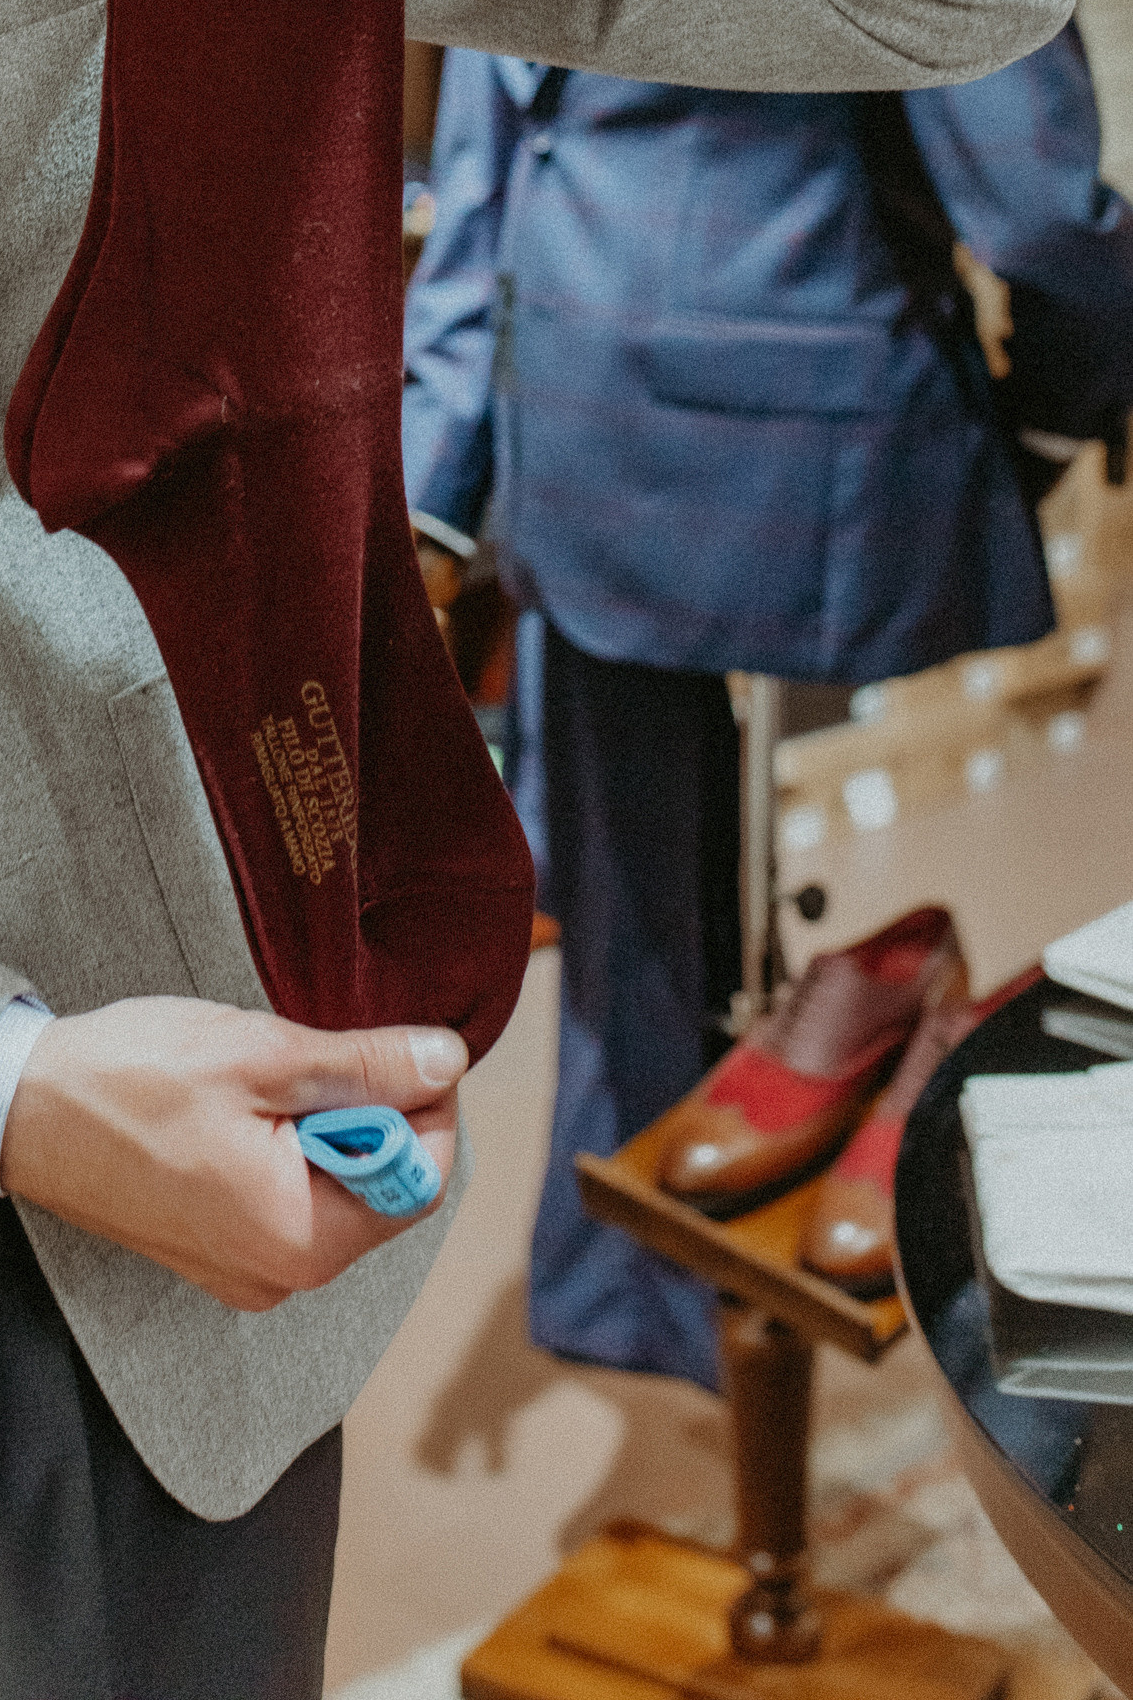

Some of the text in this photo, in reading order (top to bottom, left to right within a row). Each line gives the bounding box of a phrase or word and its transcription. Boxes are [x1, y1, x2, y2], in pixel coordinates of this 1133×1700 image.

[261, 713, 322, 885] TALLONE RINFORZATO
[277, 716, 336, 872] FILO DI SCOZIA
[305, 748, 328, 791] DAL
[283, 830, 306, 875] MANO
